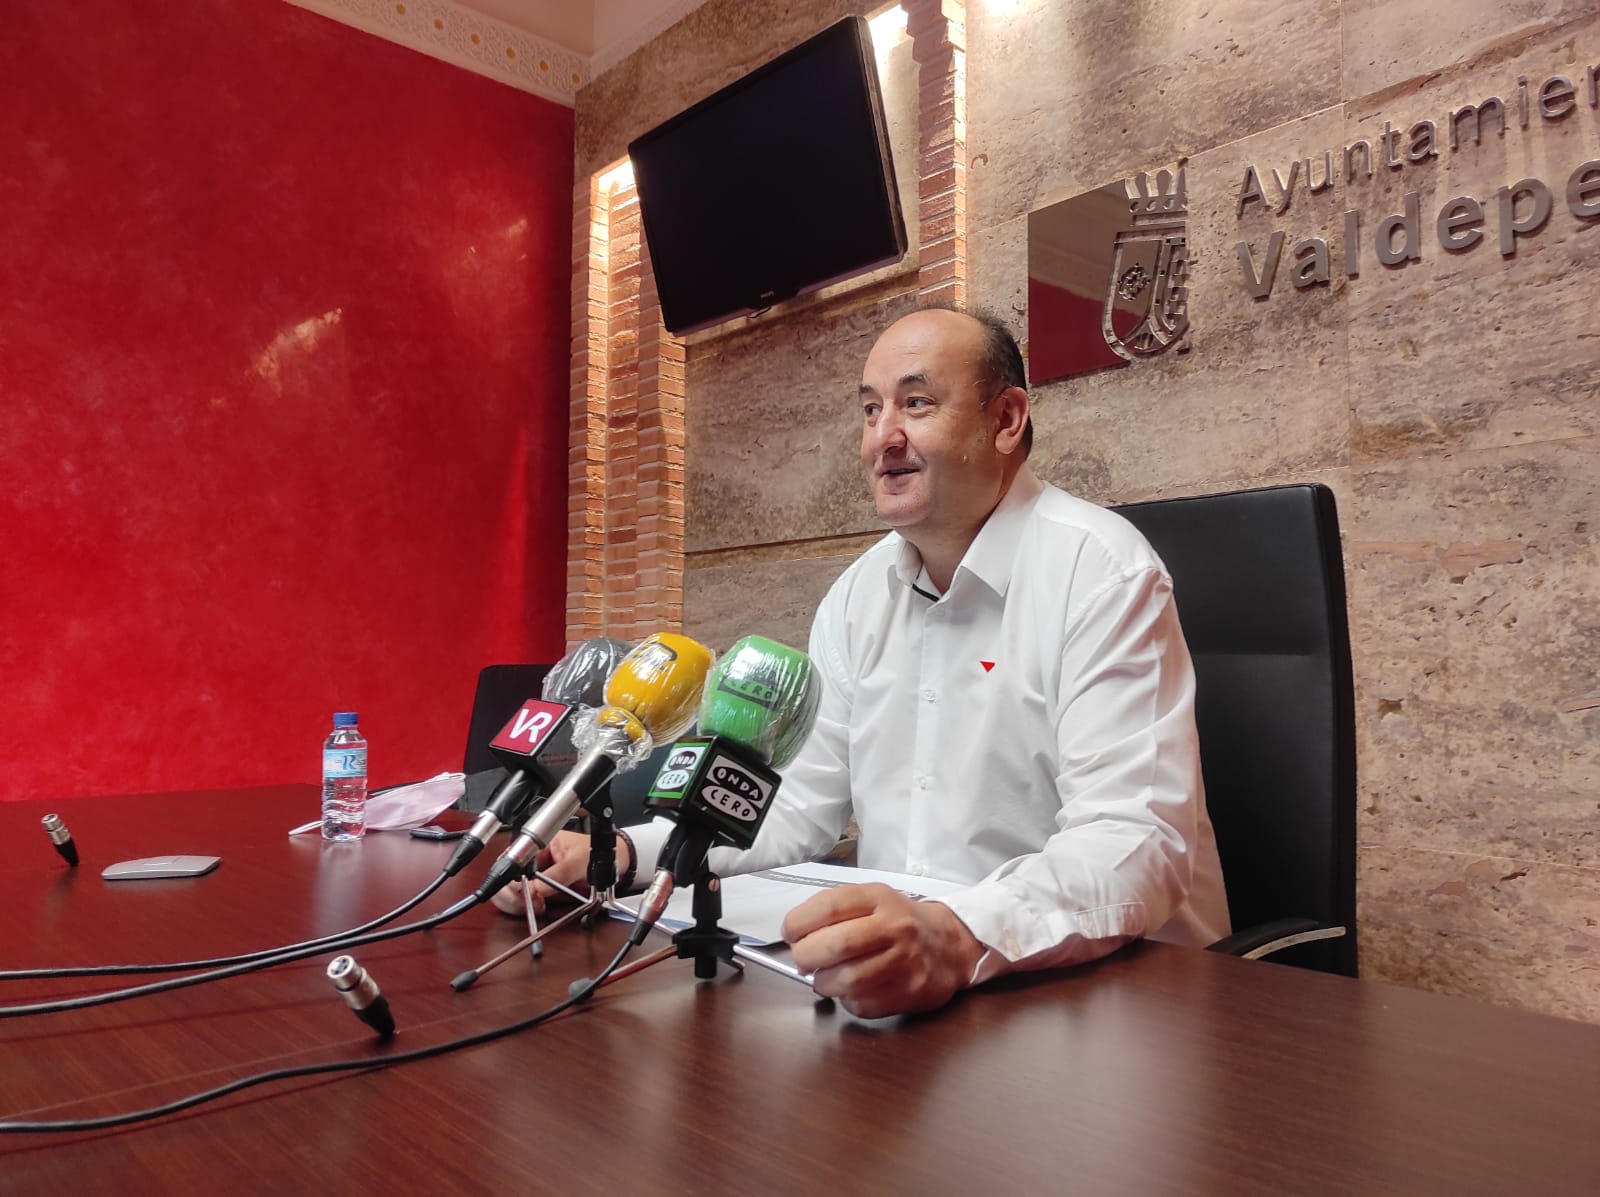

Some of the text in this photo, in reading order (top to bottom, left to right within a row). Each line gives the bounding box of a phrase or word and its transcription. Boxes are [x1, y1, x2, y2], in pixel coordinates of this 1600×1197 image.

[1235, 158, 1600, 300] Valdepe
[509, 708, 553, 743] VR
[717, 767, 760, 800] ONDA
[711, 789, 751, 817] CERO
